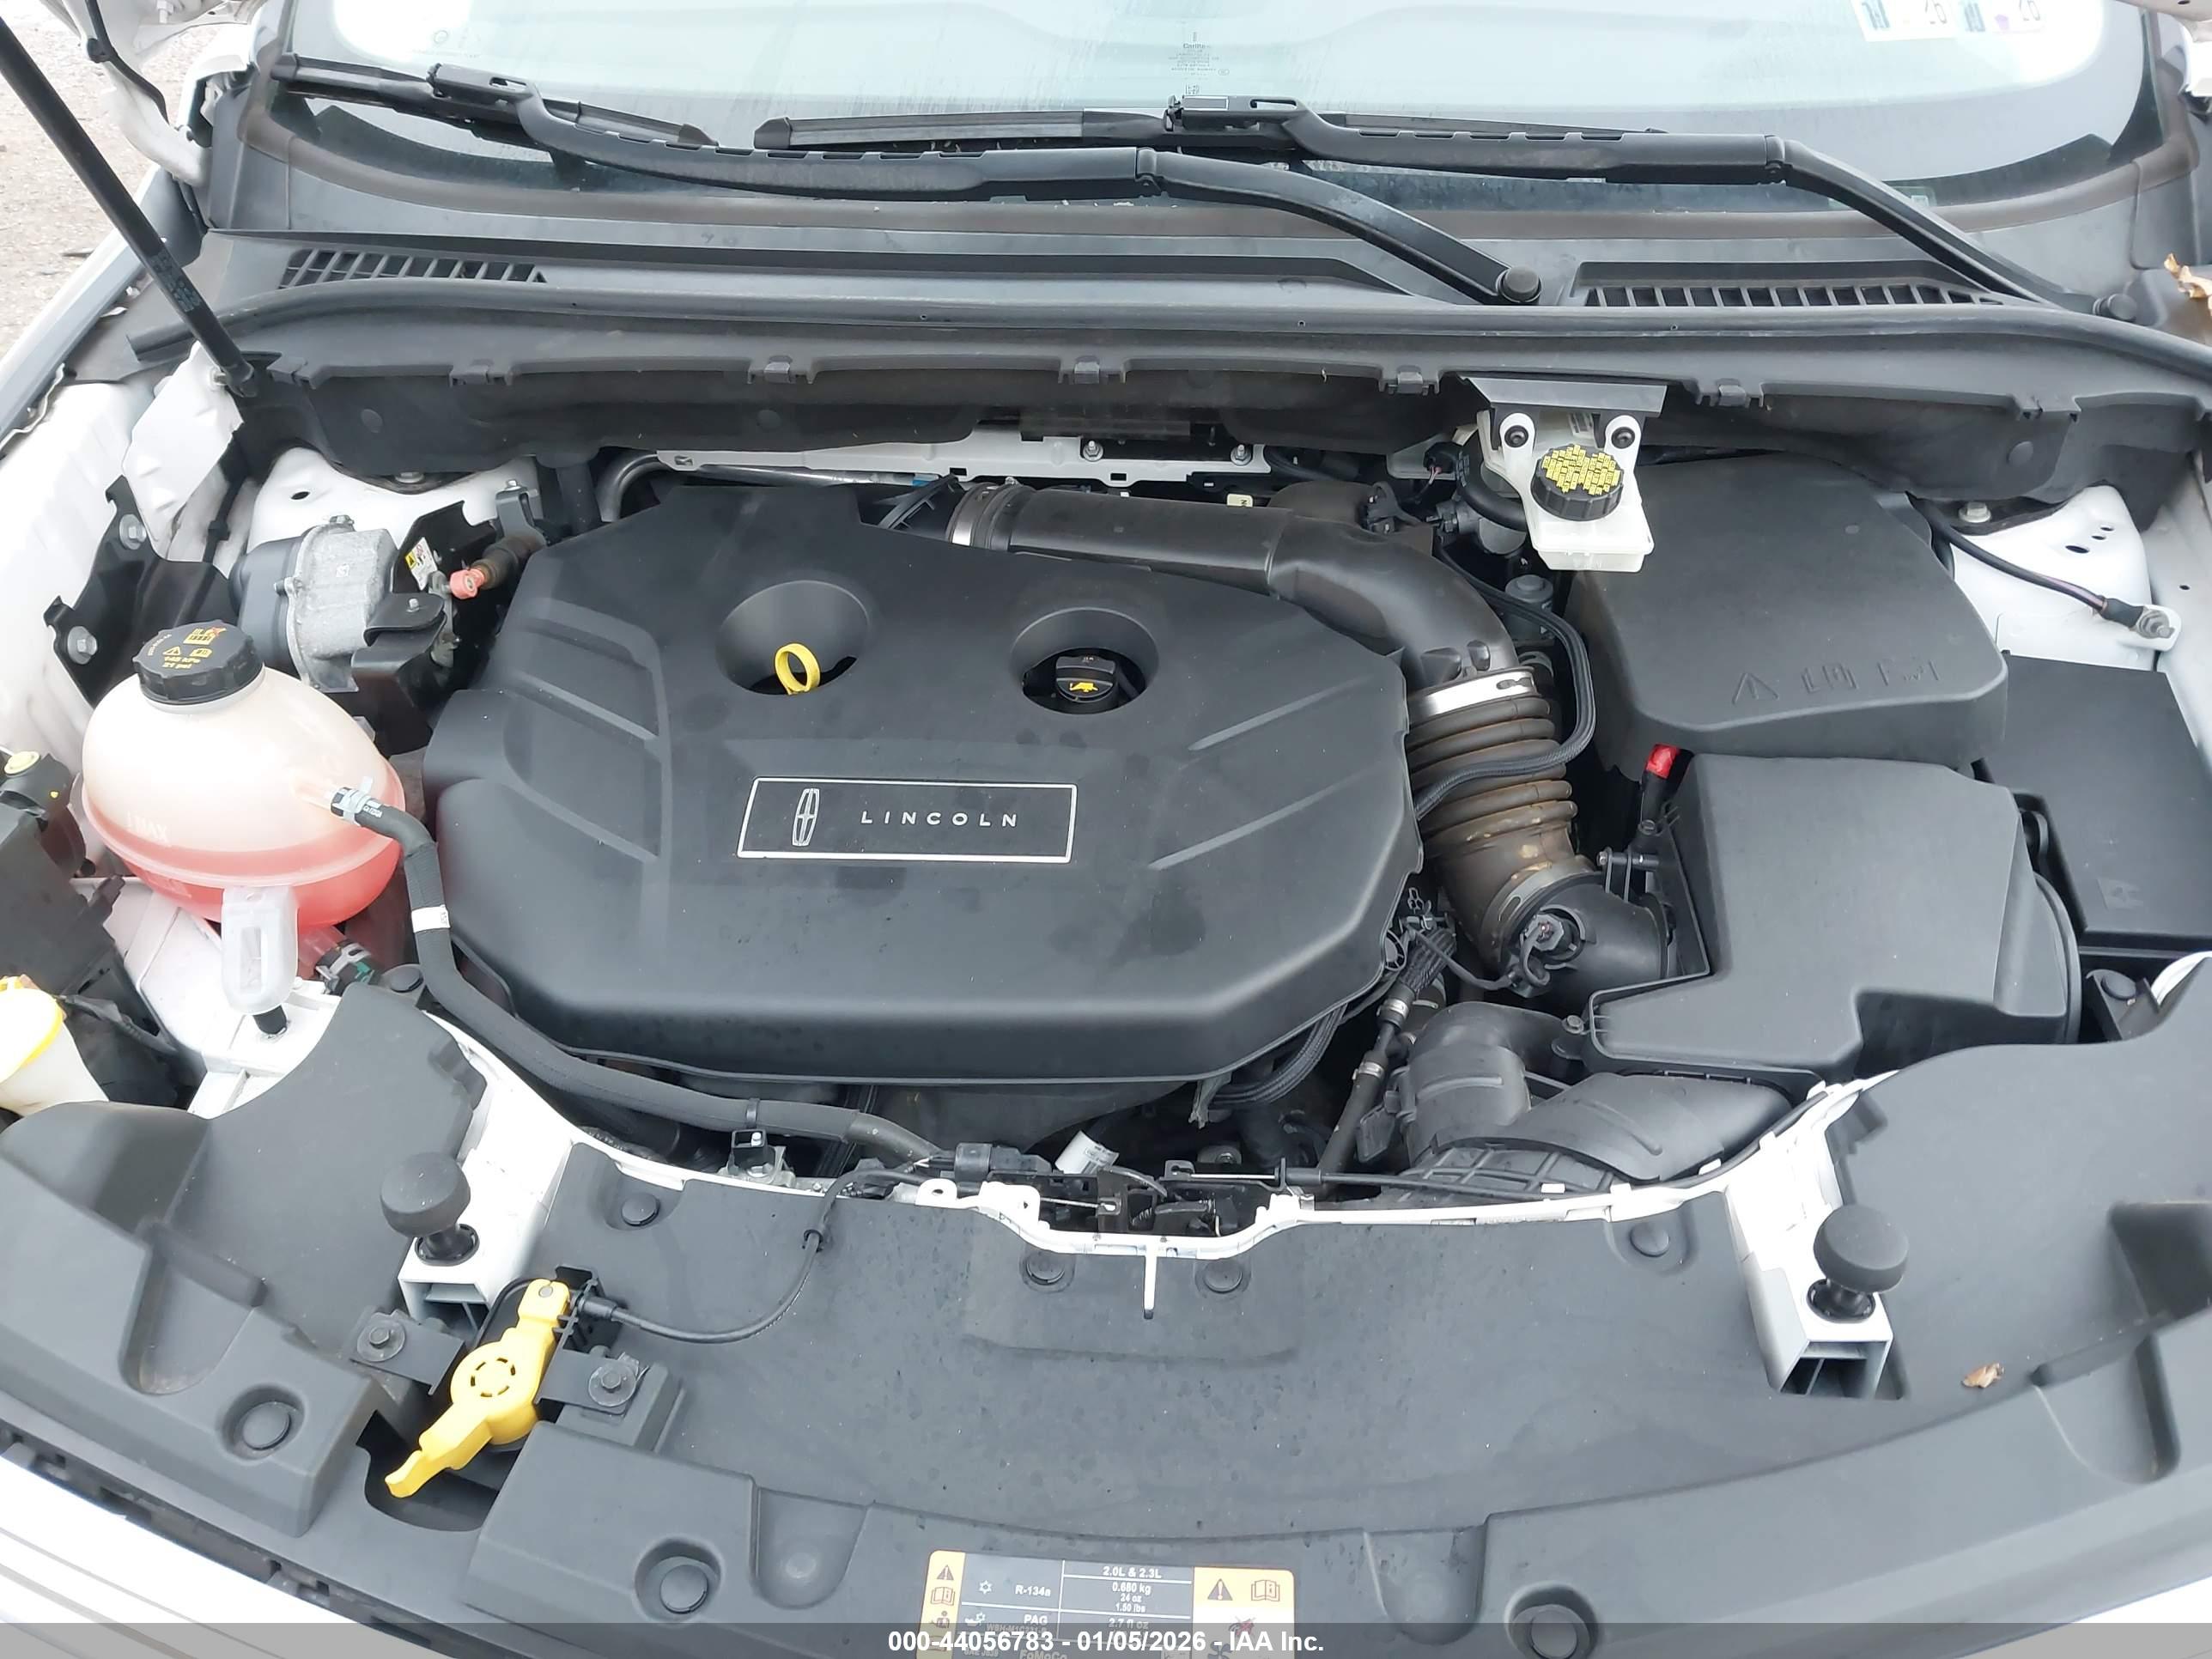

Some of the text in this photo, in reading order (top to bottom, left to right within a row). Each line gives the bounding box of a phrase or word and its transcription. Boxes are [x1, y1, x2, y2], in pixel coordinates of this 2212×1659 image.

[860, 811, 1018, 828] LINCOLN
[1103, 1566, 1162, 1579] 2.0L & 2.3L
[1015, 1584, 1052, 1597] R-134a
[1112, 1582, 1152, 1595] 0.680 kg
[1120, 1593, 1130, 1602] 24
[1115, 1603, 1146, 1613] 1.50 lbs
[1024, 1614, 1048, 1626] PAG
[1109, 1618, 1125, 1628] 2.7
[1136, 1621, 1149, 1630] oz
